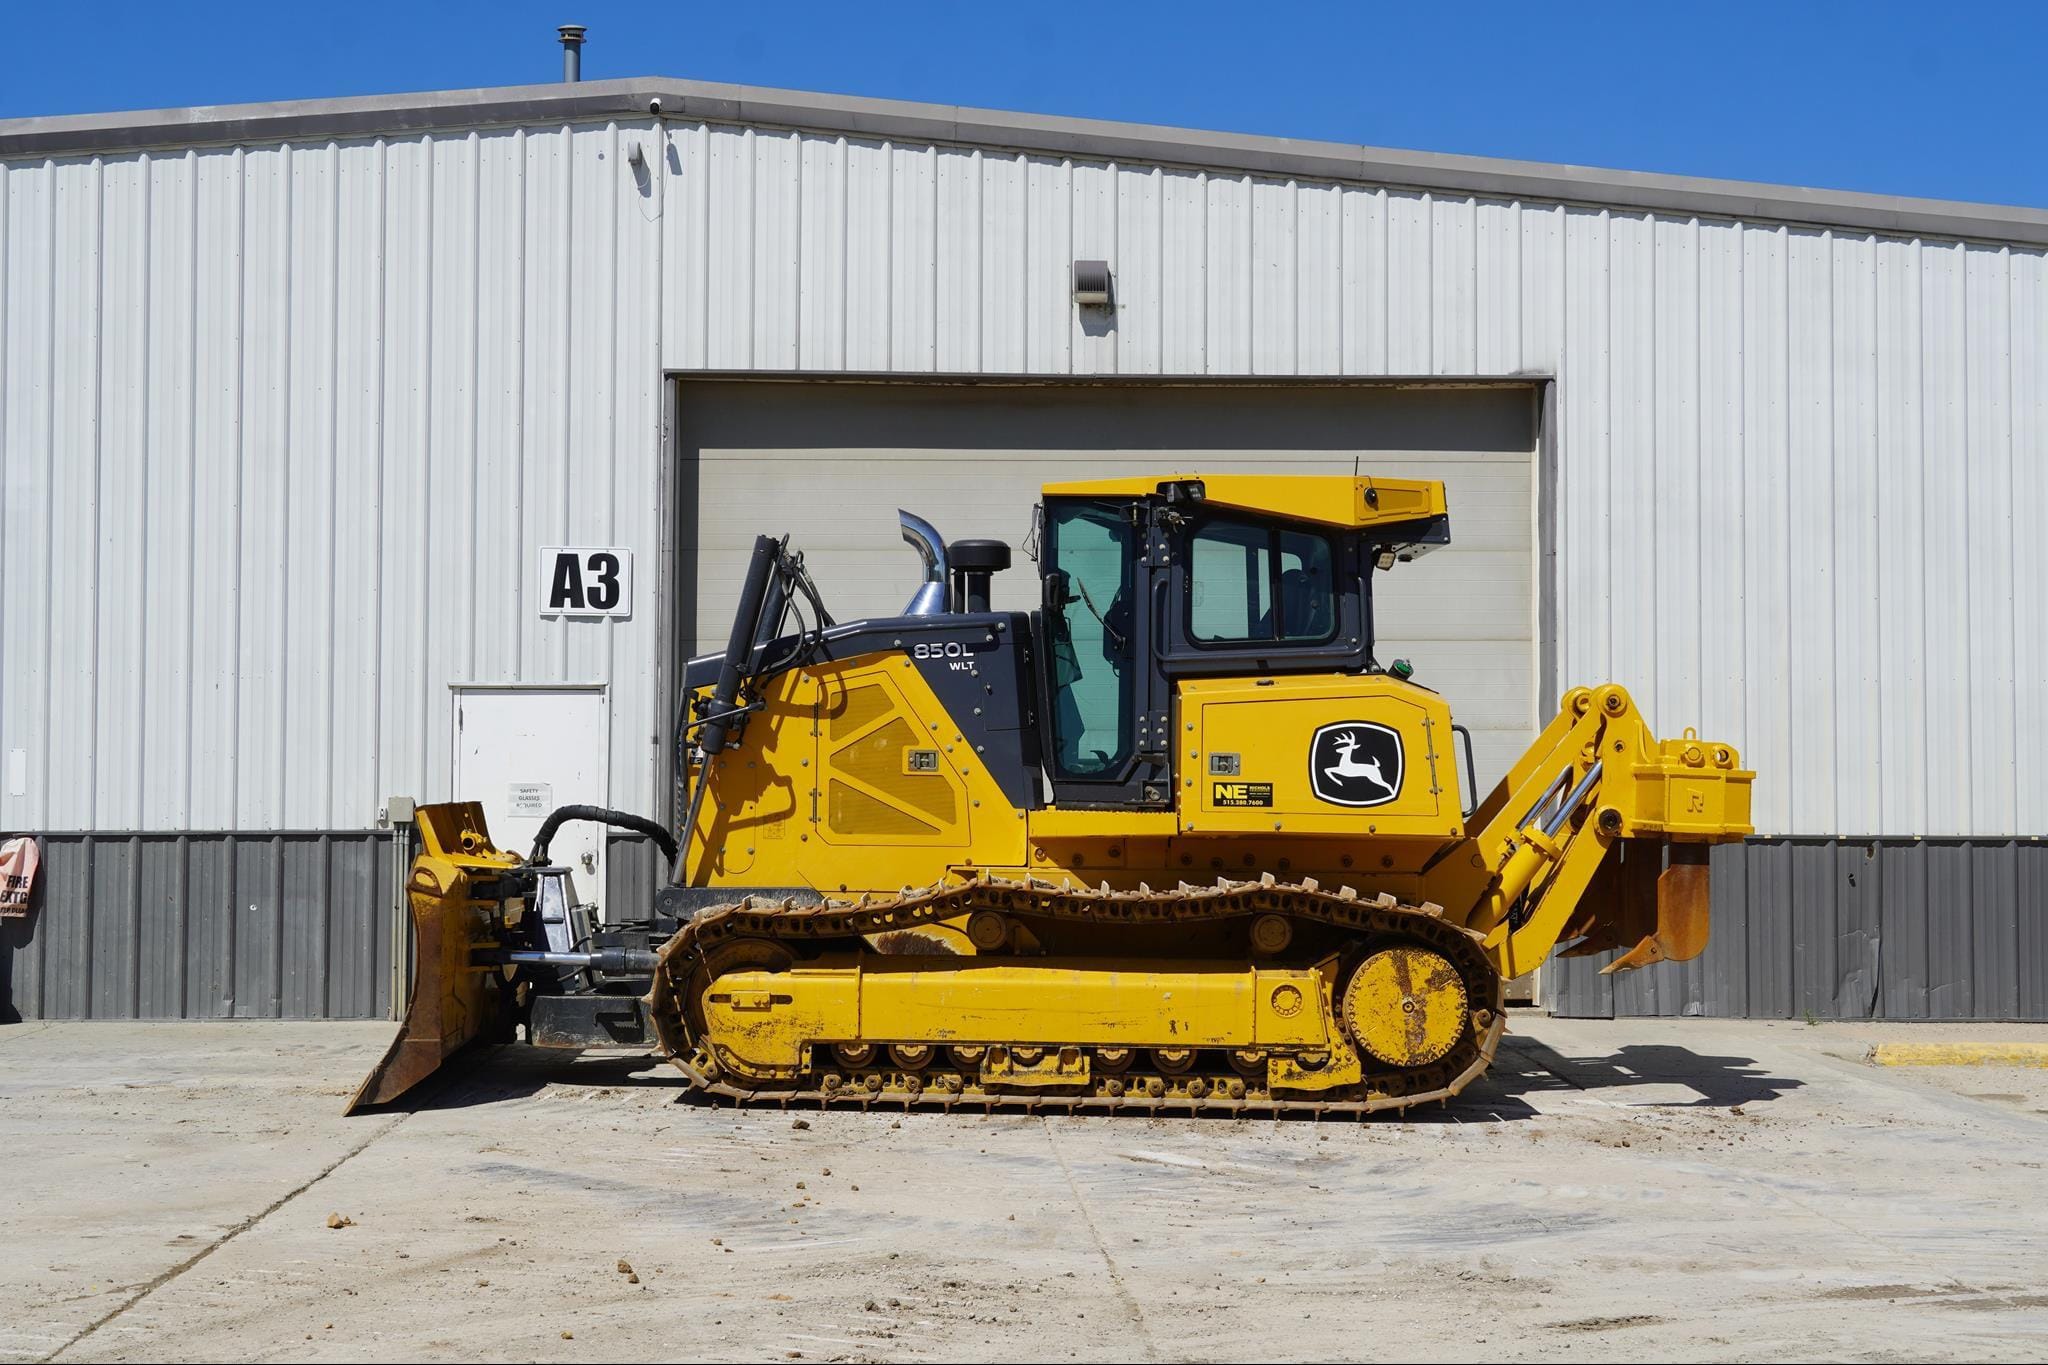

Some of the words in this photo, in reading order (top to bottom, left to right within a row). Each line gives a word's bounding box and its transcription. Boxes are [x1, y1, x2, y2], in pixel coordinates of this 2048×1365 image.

[549, 552, 620, 610] A3
[913, 642, 975, 659] 850L
[949, 661, 975, 671] WLT
[1215, 784, 1248, 799] NE
[6, 874, 29, 889] FIRE
